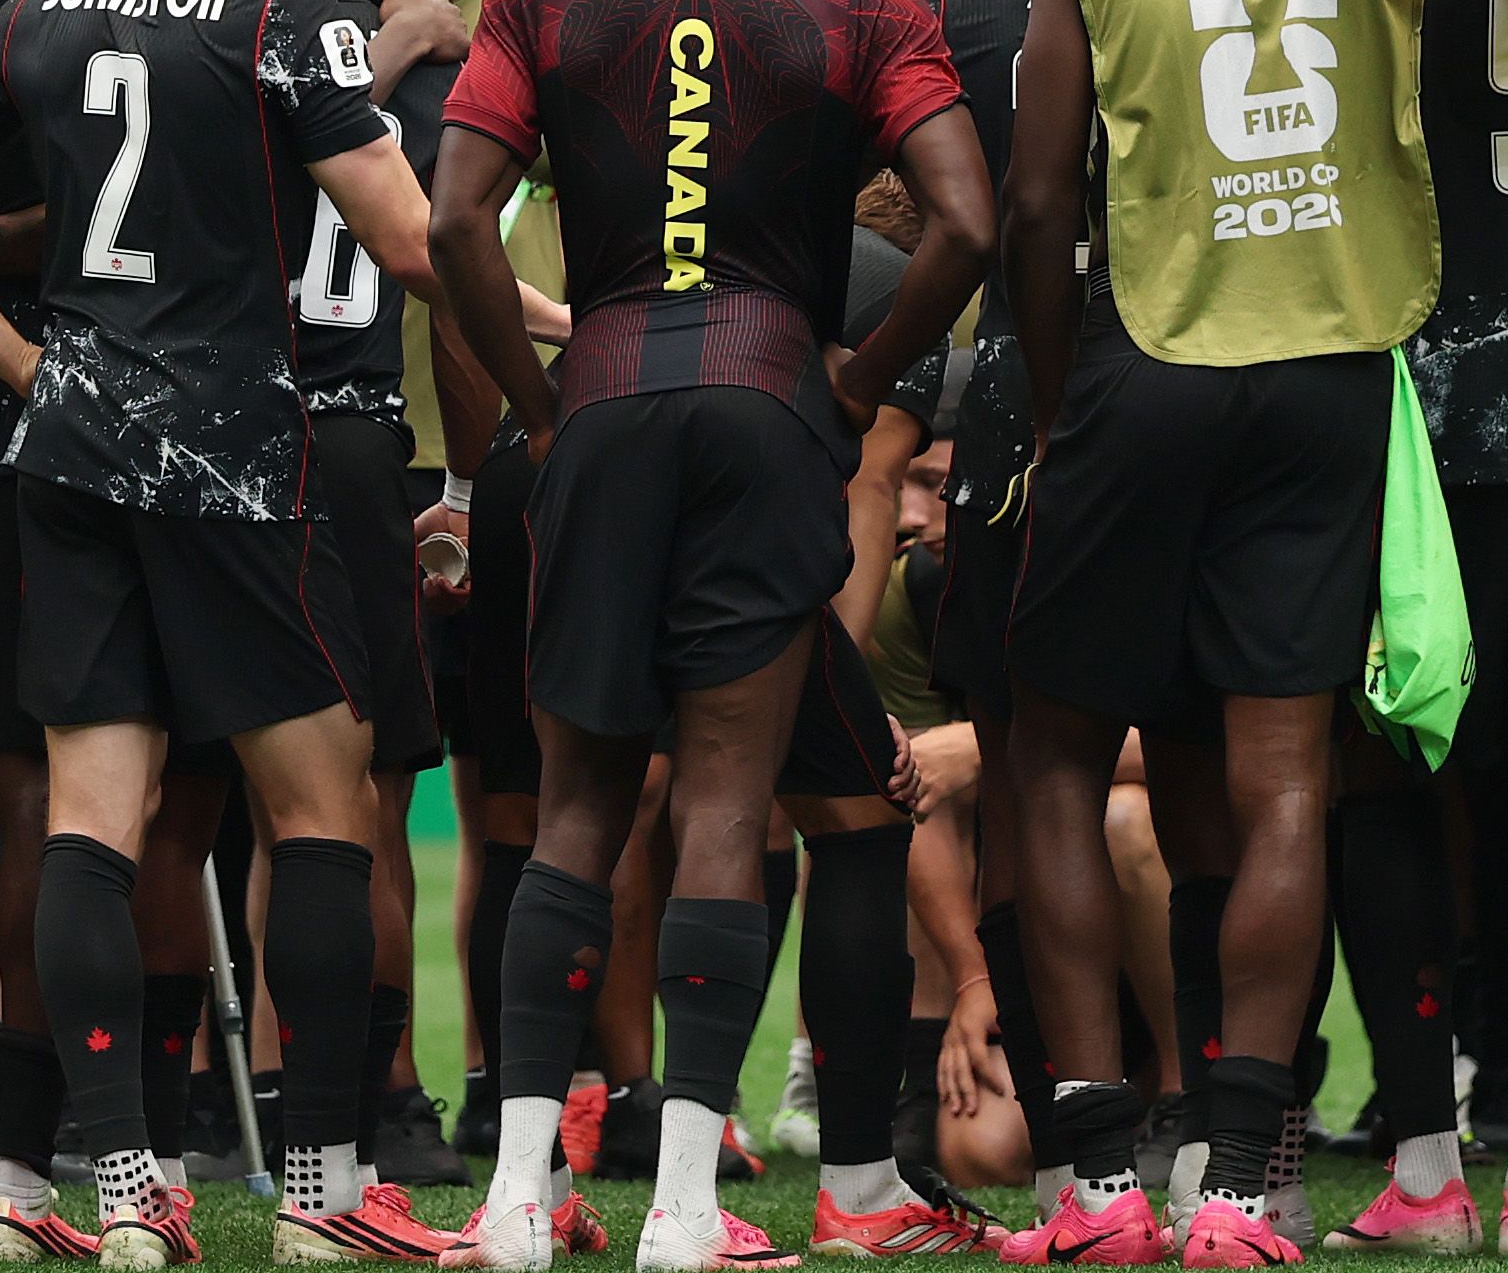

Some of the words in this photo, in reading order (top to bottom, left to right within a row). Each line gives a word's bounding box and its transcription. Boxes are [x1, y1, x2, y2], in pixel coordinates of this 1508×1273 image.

[82, 50, 156, 284] 2
[663, 18, 714, 292] CANADA
[1210, 168, 1306, 199] WORLD
[1244, 102, 1316, 136] FIFA
